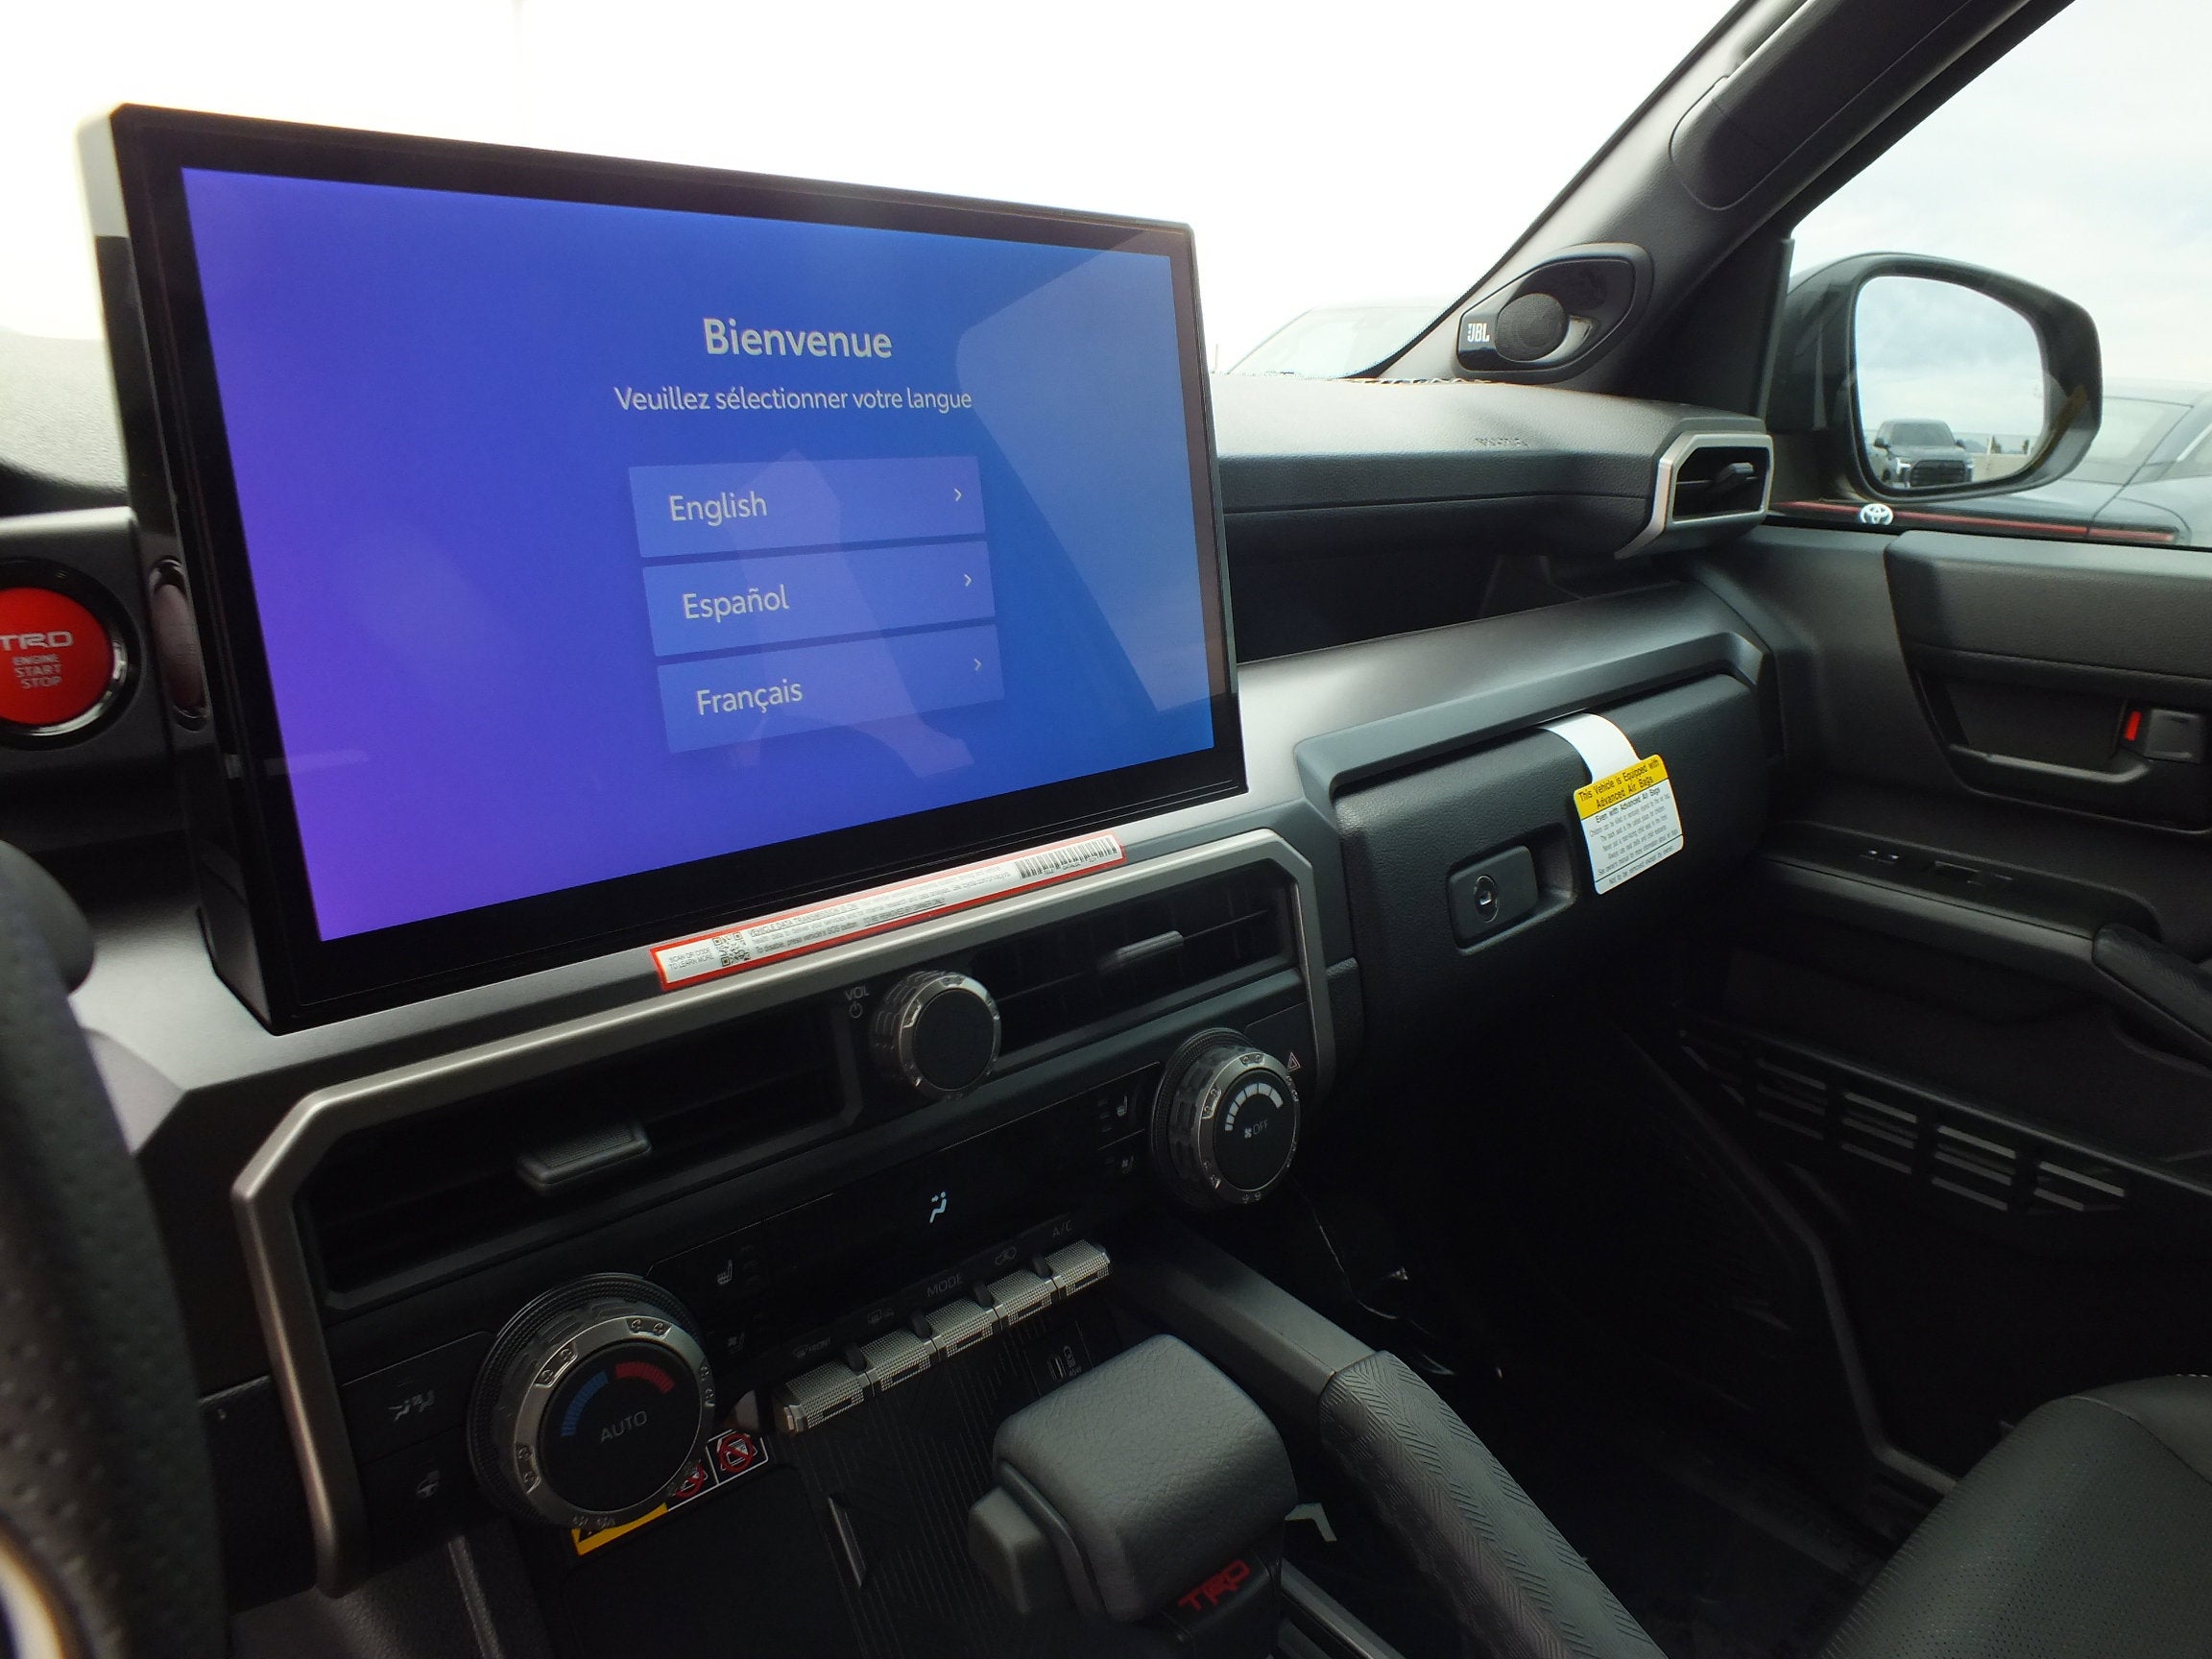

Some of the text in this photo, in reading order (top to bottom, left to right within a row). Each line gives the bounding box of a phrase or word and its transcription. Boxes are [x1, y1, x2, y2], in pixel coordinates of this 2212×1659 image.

[704, 317, 893, 359] Bienvenue
[1467, 322, 1491, 343] JBL
[614, 385, 973, 414] Veuillez sélectionner votre langue
[668, 491, 767, 527] English
[683, 584, 789, 622] Español
[0, 631, 74, 651] TRD
[12, 653, 60, 665] ENGINE
[14, 664, 62, 678] START
[21, 676, 62, 689] STOP
[697, 679, 803, 716] Français
[1578, 758, 1660, 802] This Vehicle is Equipped with
[1596, 776, 1653, 809] Advanced Air Bags
[751, 924, 775, 938] VEHICLE
[777, 919, 794, 930] DATA
[845, 984, 870, 1000] VOL
[1253, 1119, 1268, 1135] OFF
[1052, 1219, 1073, 1238] A/C
[926, 1272, 964, 1297] MODE
[600, 1410, 648, 1444] AUTO
[1177, 1558, 1251, 1613] TRD
